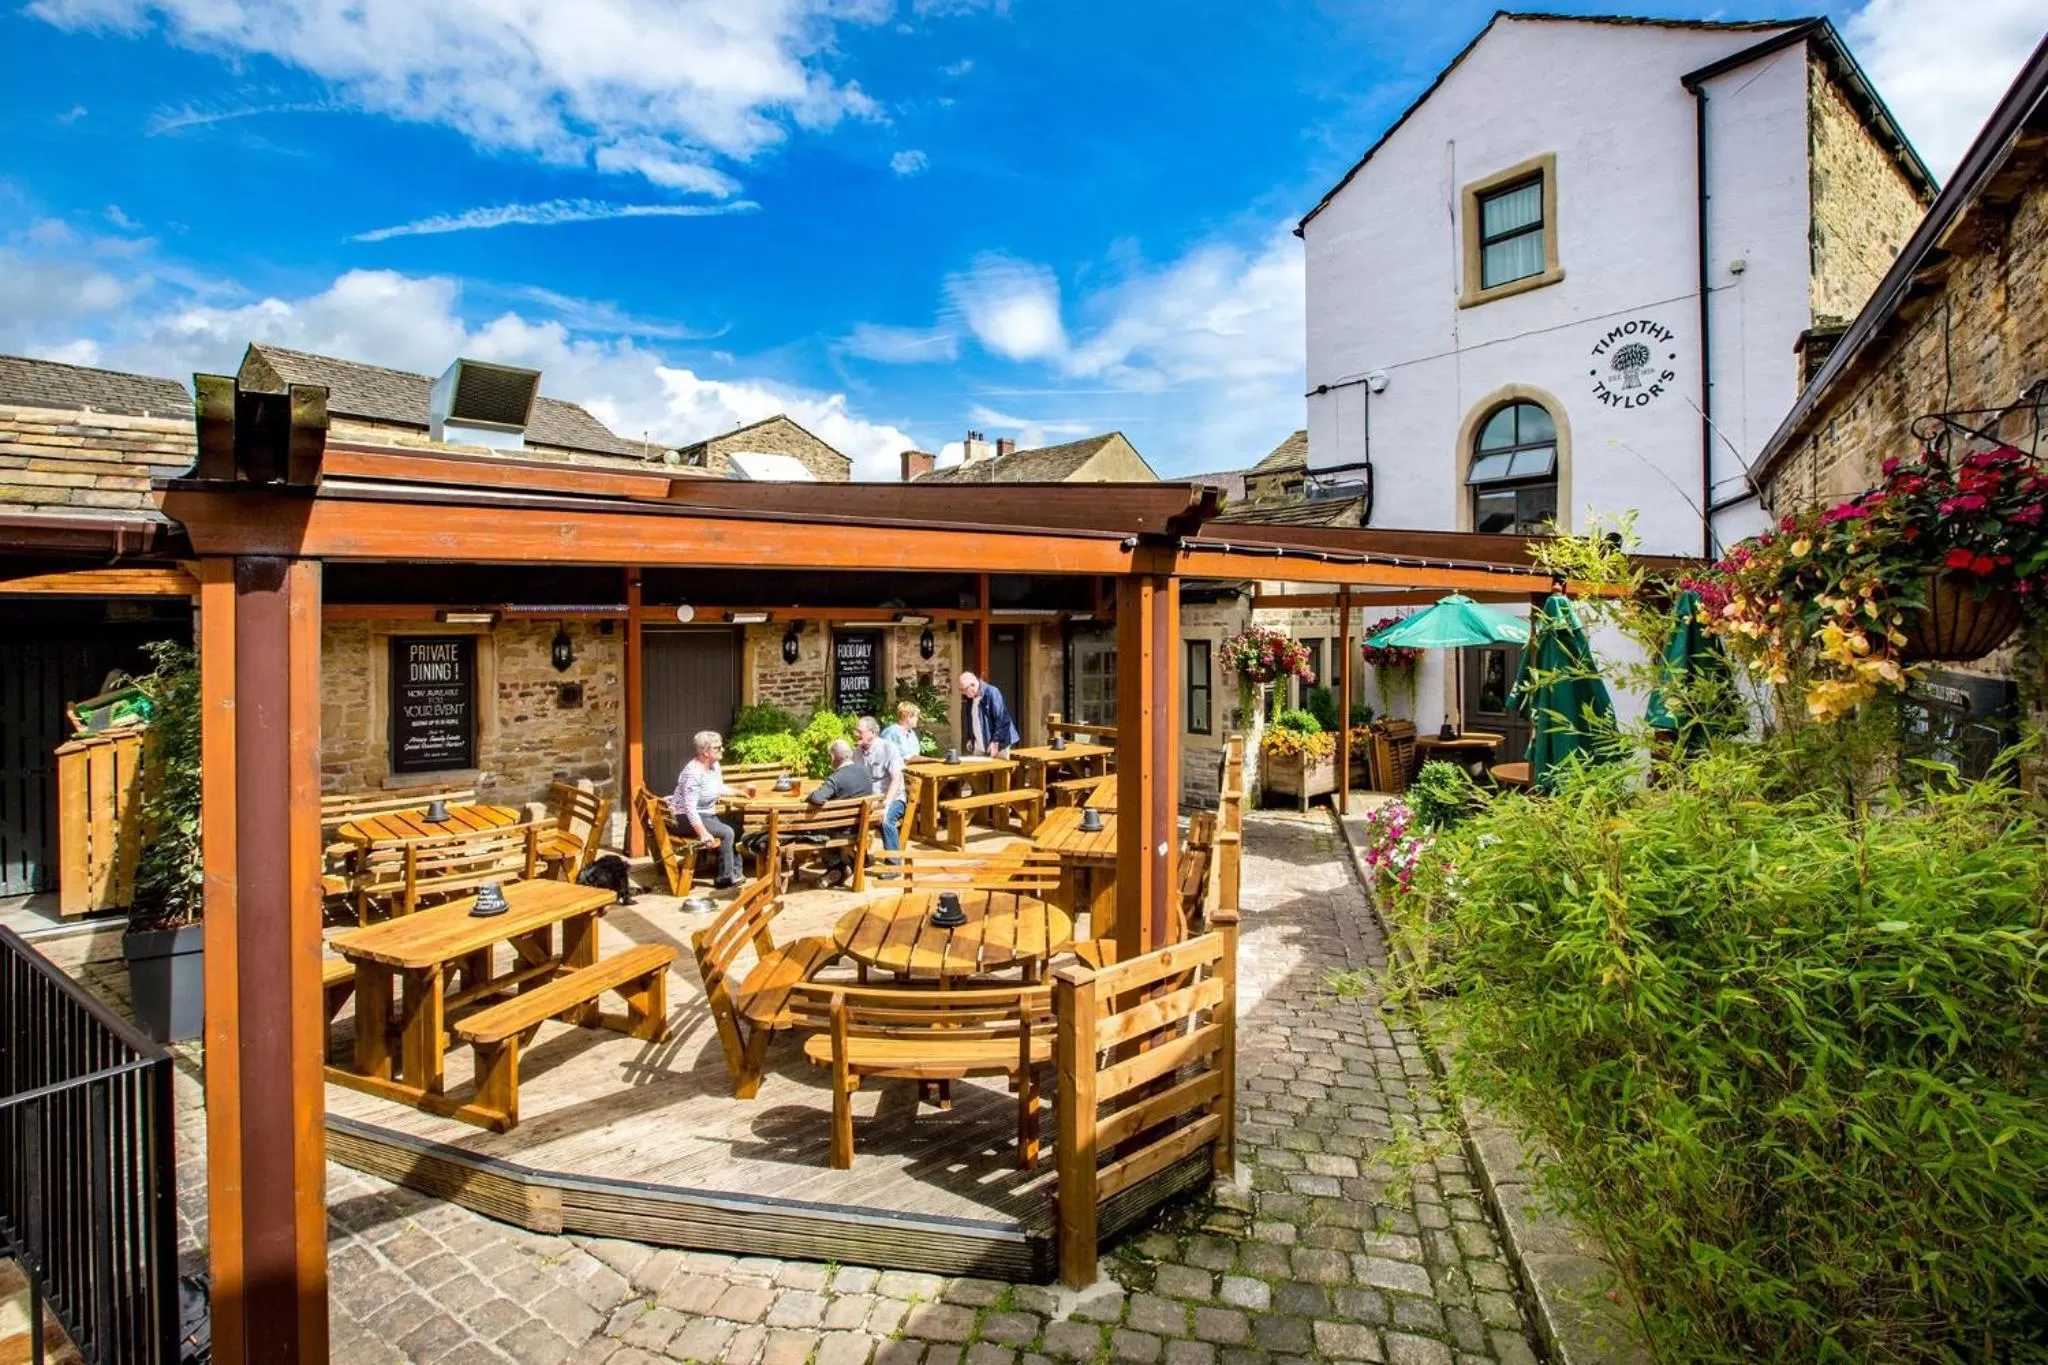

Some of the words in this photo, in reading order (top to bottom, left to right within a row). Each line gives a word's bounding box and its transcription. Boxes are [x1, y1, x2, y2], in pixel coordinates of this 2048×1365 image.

[1591, 320, 1674, 355] TIMOTHY
[1592, 370, 1675, 408] TAYLOR'S
[410, 644, 458, 662] PRIVATE
[837, 644, 855, 658] FOOD
[855, 644, 872, 657] DAILY
[840, 677, 854, 691] BAR
[854, 676, 870, 690] OPEN
[403, 705, 433, 717] YOUR
[433, 703, 465, 716] EVENT
